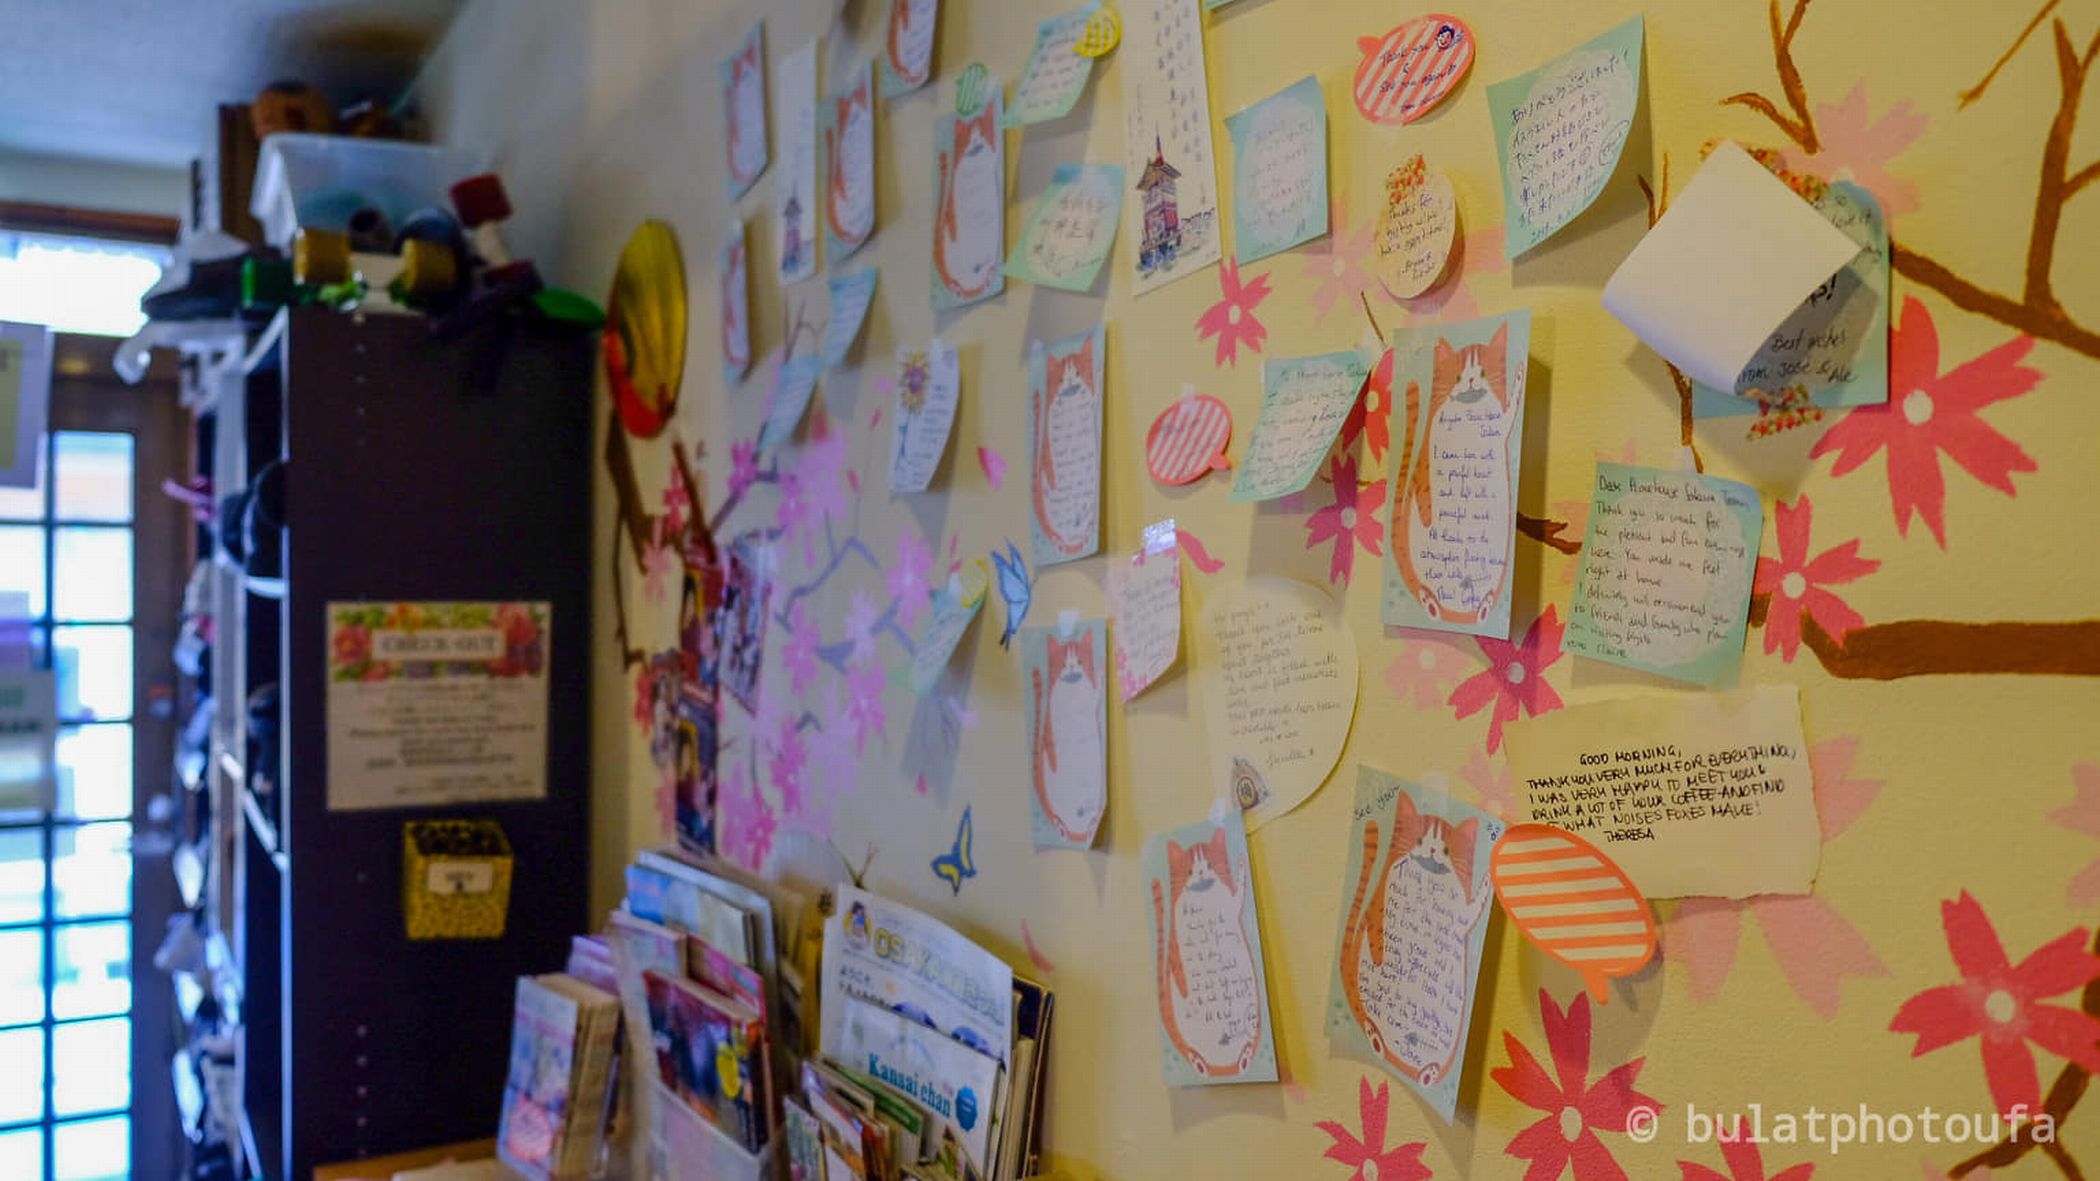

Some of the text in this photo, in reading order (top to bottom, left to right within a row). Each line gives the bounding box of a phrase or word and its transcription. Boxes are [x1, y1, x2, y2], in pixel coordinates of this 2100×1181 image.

[1526, 775, 1570, 790] THANK
[1570, 773, 1595, 786] YOU
[1595, 766, 1631, 782] VERY
[1634, 760, 1673, 777] MUCH
[1674, 754, 1707, 772] FOR
[1580, 745, 1682, 766] GOOD MORNING,
[1529, 793, 1535, 805] I
[1538, 792, 1568, 804] WAS
[1570, 786, 1607, 801] VERY
[1610, 779, 1662, 797] HAPPY
[1667, 779, 1681, 792] TO
[1686, 768, 1729, 788] MEET
[1729, 767, 1757, 783] YOU
[1531, 804, 1572, 821] DRINK
[1575, 804, 1585, 817] A
[1588, 802, 1605, 814] LOT
[1609, 799, 1627, 812] OF
[1631, 795, 1666, 809] YOUR
[1671, 787, 1717, 806] COFFEE
[1563, 816, 1605, 832] WHAT
[1613, 807, 1663, 826] NOISES
[1666, 805, 1706, 821] FOXES
[1603, 828, 1655, 843] THERESA
[868, 1052, 920, 1099] Kansai
[920, 1079, 953, 1121] chan
